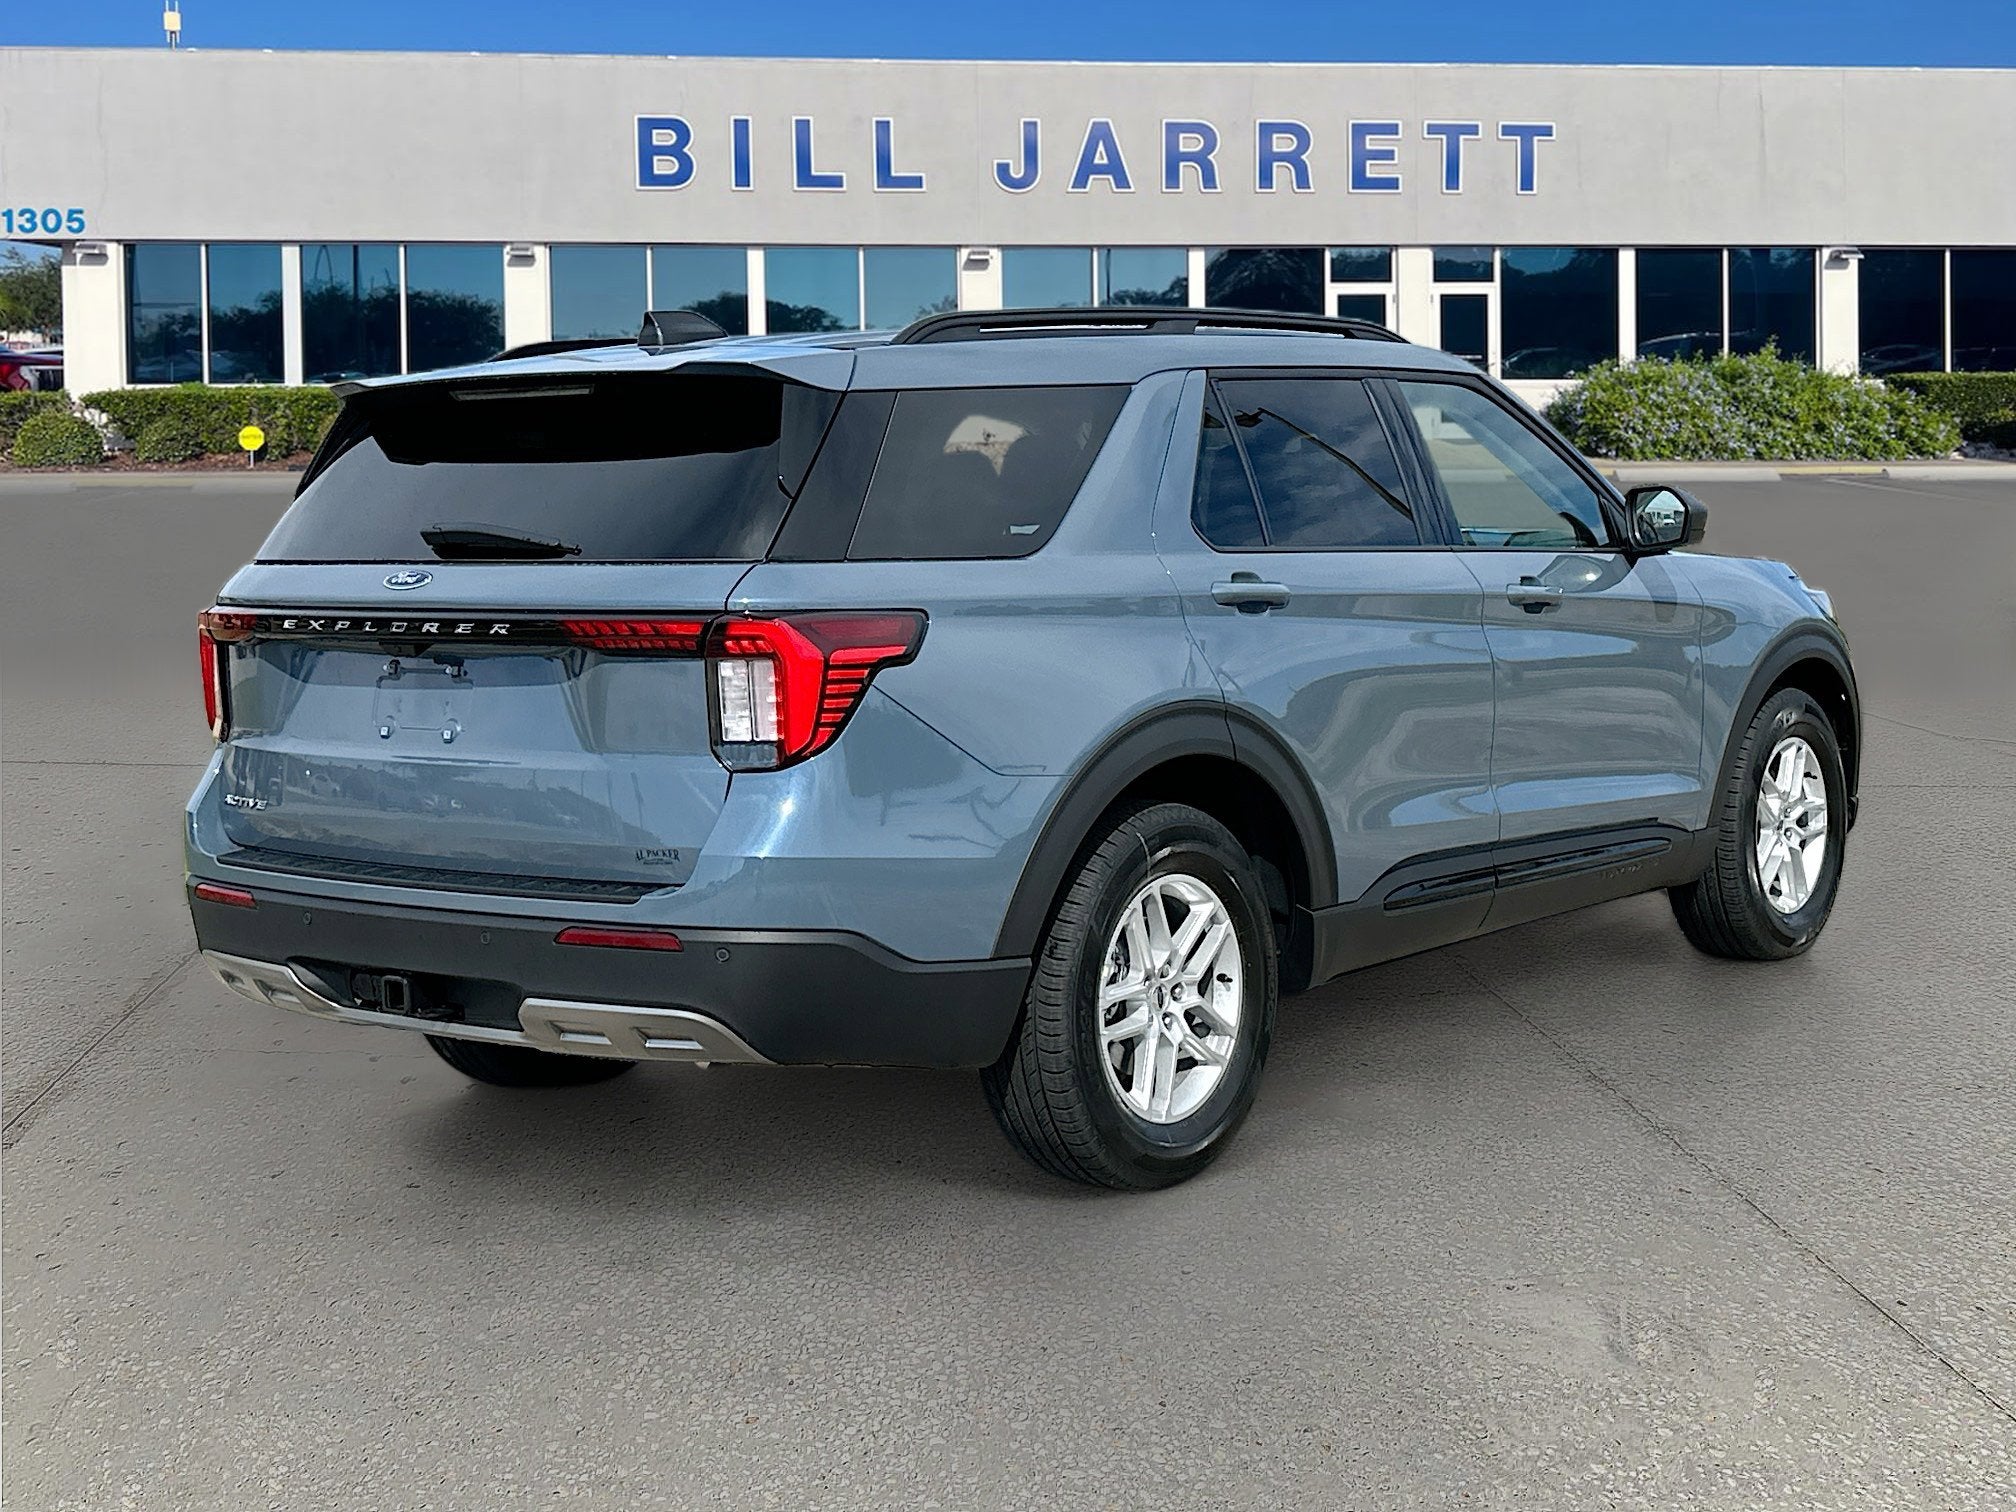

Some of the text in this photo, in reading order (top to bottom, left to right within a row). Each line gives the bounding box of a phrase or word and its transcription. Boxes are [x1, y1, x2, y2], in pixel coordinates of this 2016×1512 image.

[634, 114, 1556, 196] BILL JARRETT
[1, 207, 86, 234] 1305
[282, 618, 511, 635] EXPLORER
[224, 794, 268, 811] ACTIVE
